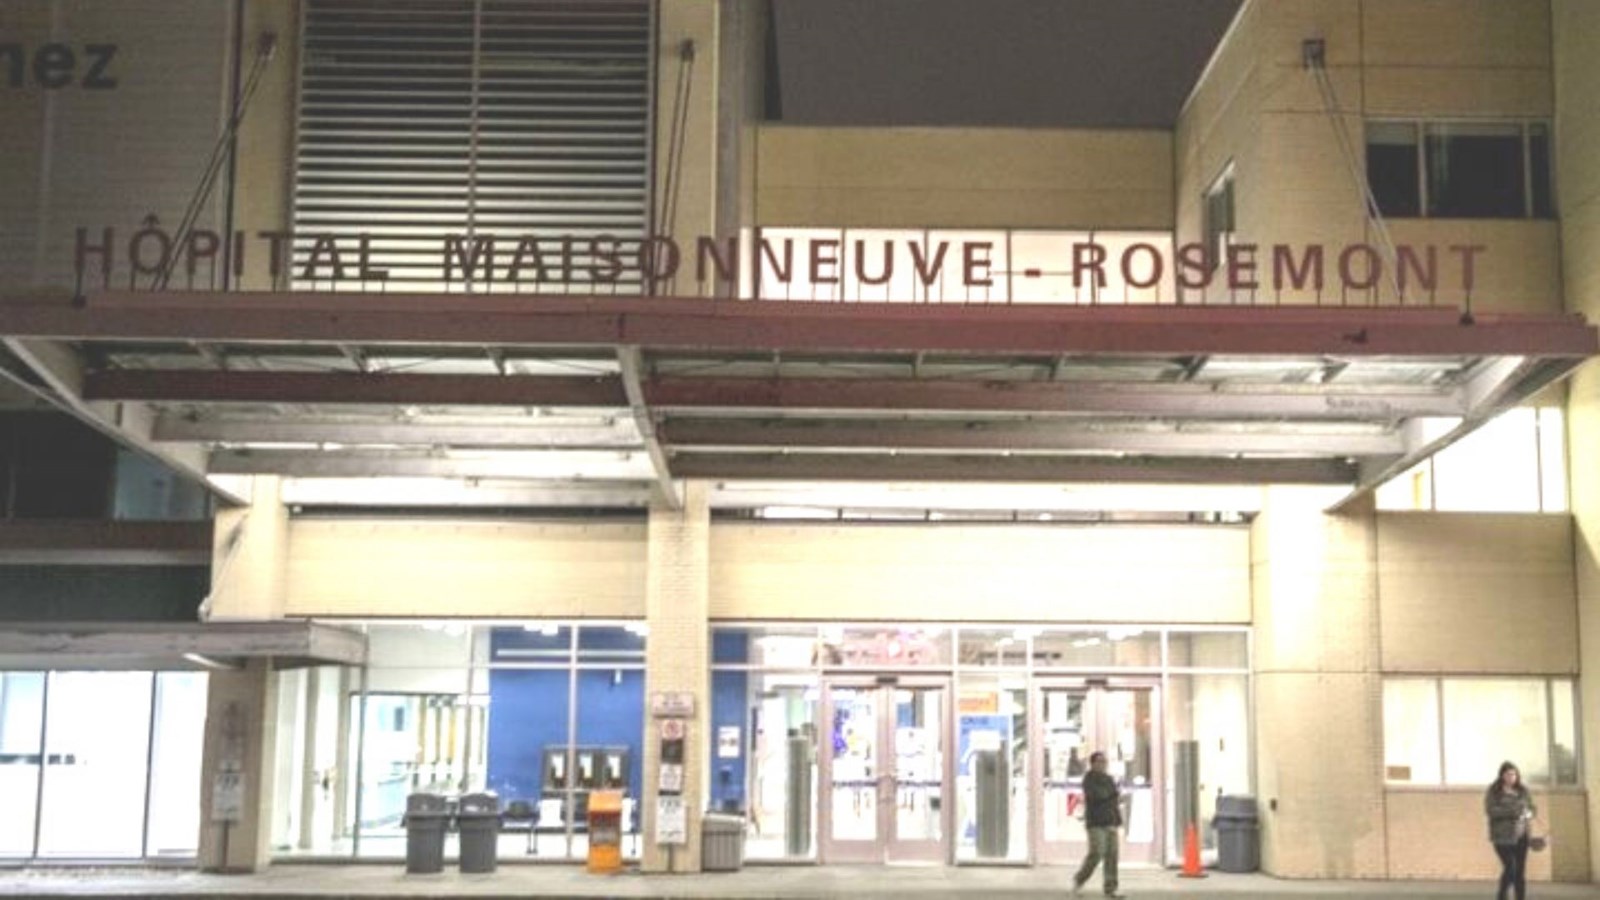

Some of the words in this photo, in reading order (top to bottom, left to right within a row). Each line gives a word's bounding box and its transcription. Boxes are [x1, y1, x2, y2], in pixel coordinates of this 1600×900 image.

[75, 212, 389, 281] HÔPITAL
[441, 233, 994, 287] MAISONNEUVE
[1071, 242, 1486, 291] ROSEMONT
